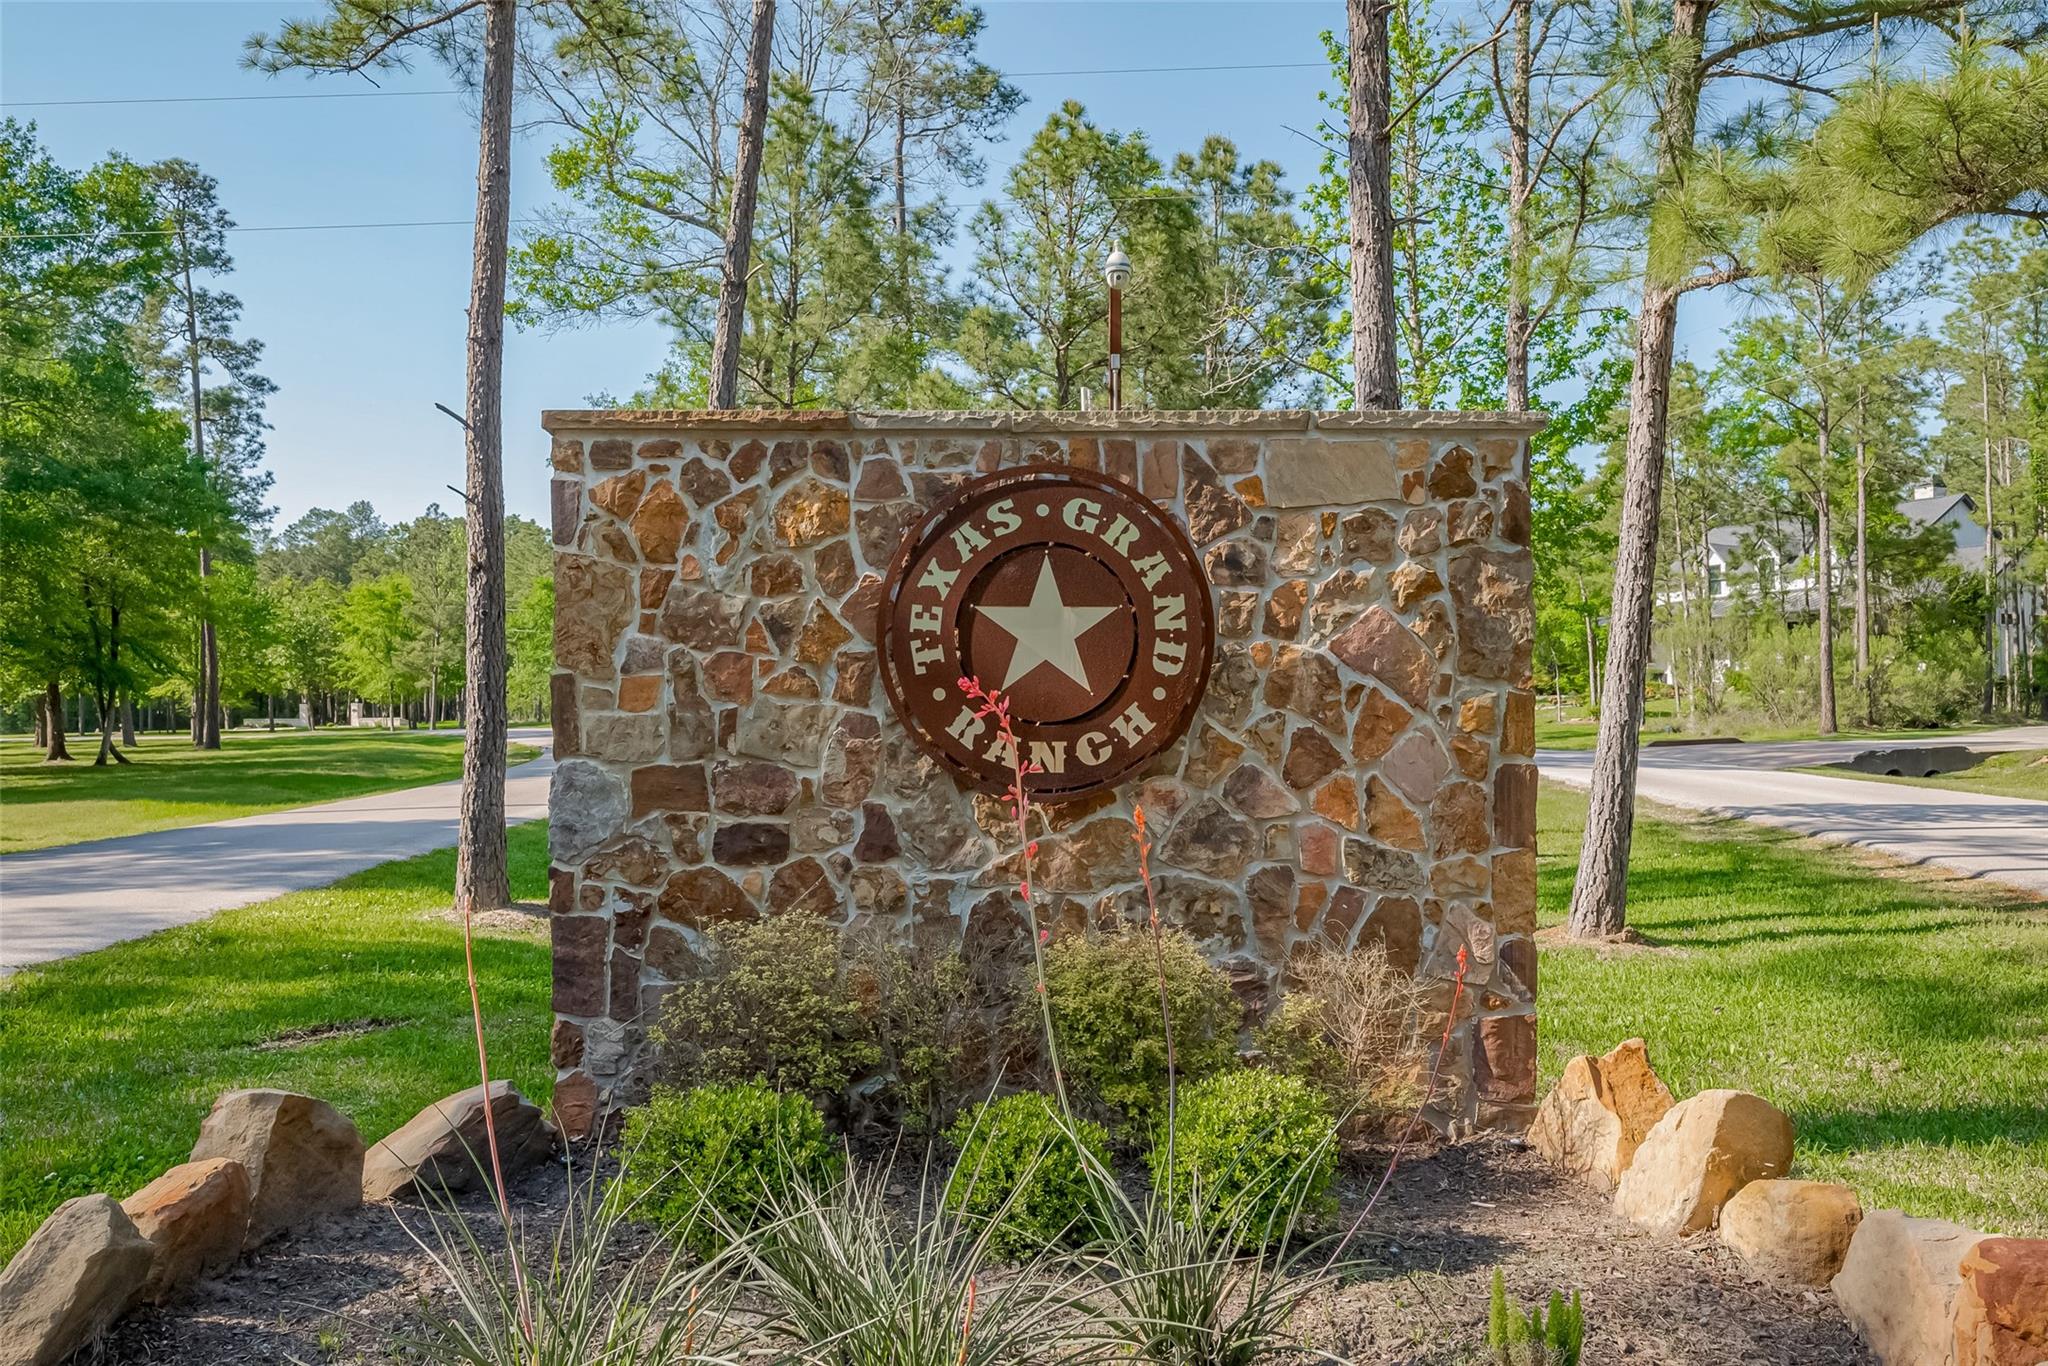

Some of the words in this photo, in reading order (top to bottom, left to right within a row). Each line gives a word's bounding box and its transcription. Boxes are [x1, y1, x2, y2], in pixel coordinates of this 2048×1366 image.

[909, 499, 1022, 675] TEXAS
[1062, 498, 1188, 677] GRAND
[945, 702, 1157, 774] RANCH
